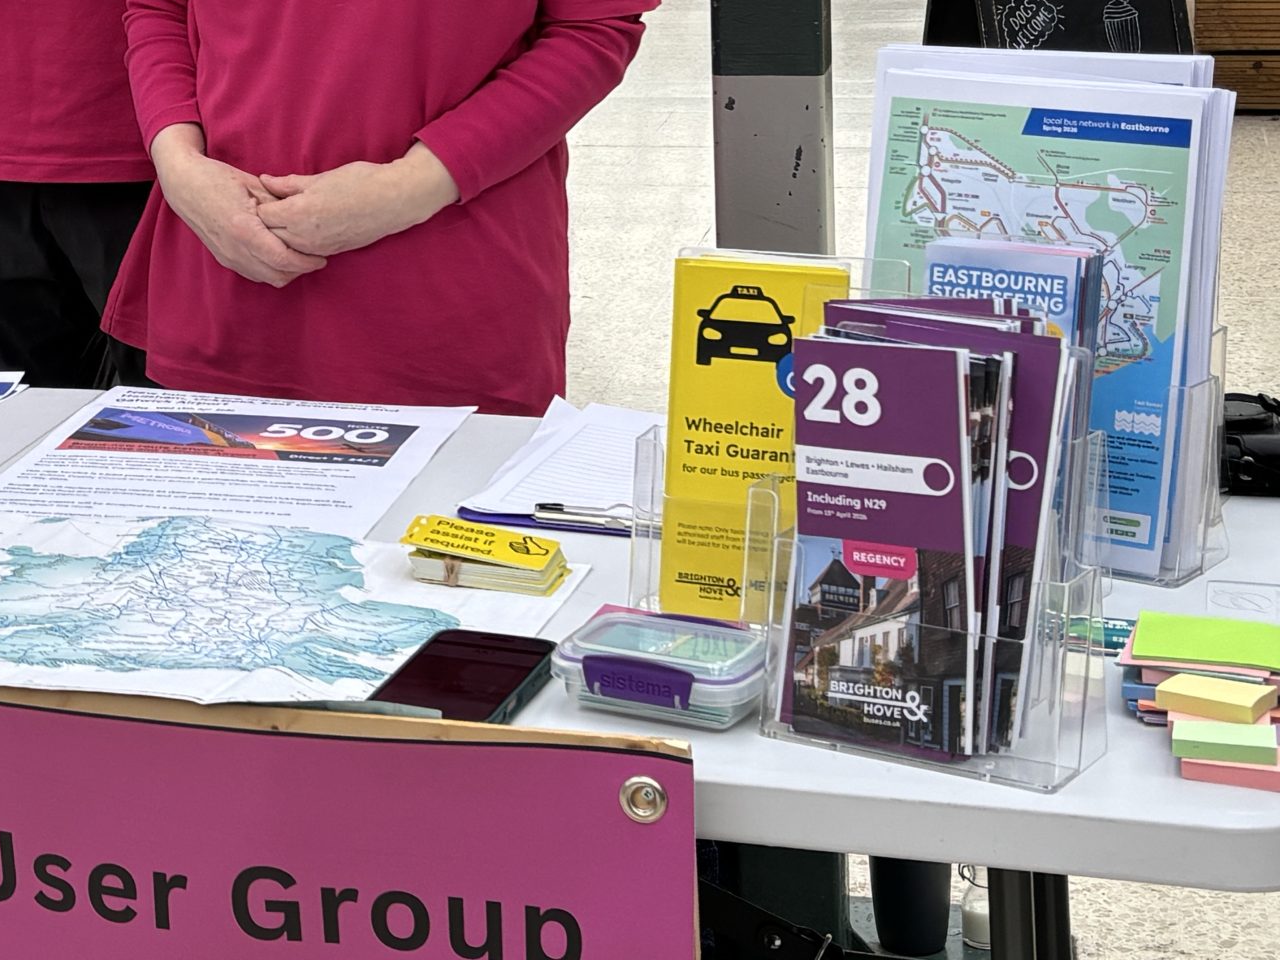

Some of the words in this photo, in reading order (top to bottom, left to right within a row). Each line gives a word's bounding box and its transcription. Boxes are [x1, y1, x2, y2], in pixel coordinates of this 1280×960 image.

[1014, 7, 1054, 50] WELCOME
[1042, 125, 1062, 133] Spring
[1043, 117, 1063, 126] local
[1064, 118, 1078, 127] bus
[1079, 120, 1110, 129] network
[1120, 123, 1169, 134] Eastbourne
[933, 267, 1064, 295] EASTBOURNE
[737, 287, 758, 295] TAXI
[802, 363, 881, 426] 28
[120, 412, 192, 435] METROBUS
[685, 417, 783, 438] Wheelchair
[258, 423, 390, 444] 500
[289, 453, 329, 461] Direct
[684, 440, 720, 456] Taxi
[726, 444, 795, 463] Guarant
[683, 464, 696, 473] for
[700, 466, 717, 476] our
[721, 467, 739, 477] bus
[806, 456, 839, 468] Brighton
[845, 460, 870, 470] Lewes
[876, 463, 913, 474] Hailsham
[806, 467, 848, 478] Eastbourne
[807, 492, 861, 509] Including
[864, 497, 887, 510] N29
[836, 511, 851, 519] April
[430, 529, 479, 543] assist
[437, 520, 495, 537] Please
[424, 536, 495, 556] required.
[852, 551, 905, 567] REGENCY
[678, 571, 724, 584] BRIGHTON
[699, 586, 723, 595] HOVE
[600, 672, 672, 698] sistema
[830, 679, 901, 700] BRIGHTON
[903, 690, 928, 722] &
[863, 703, 901, 719] HOVE
[231, 865, 584, 960] Group
